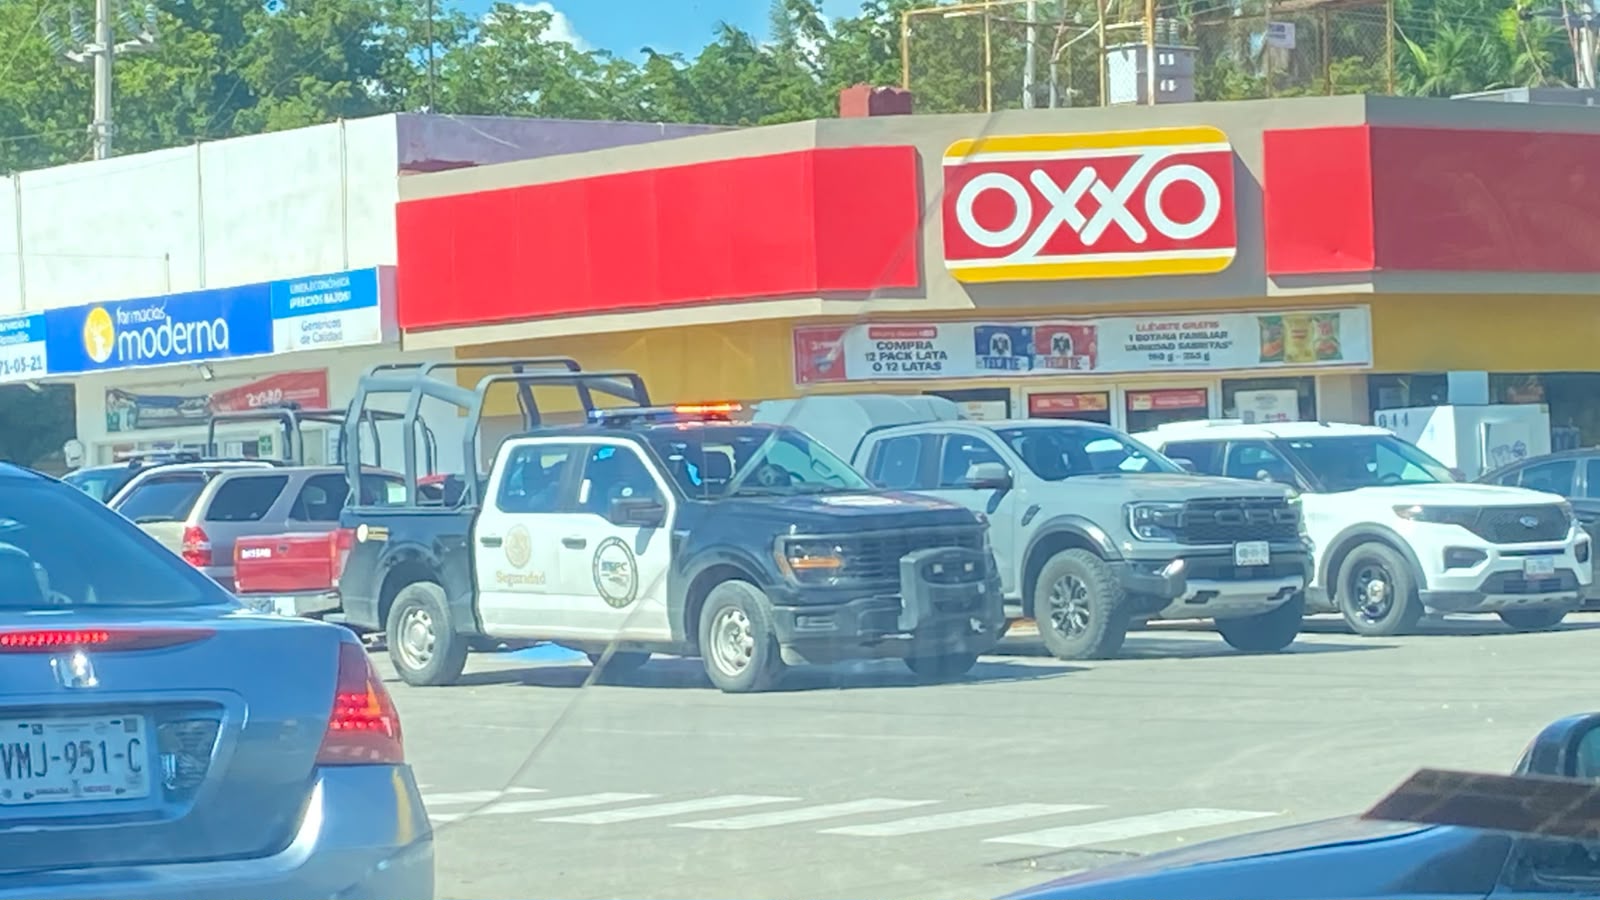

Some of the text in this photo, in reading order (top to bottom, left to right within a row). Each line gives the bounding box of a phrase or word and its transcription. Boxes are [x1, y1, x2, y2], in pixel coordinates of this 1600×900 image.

[956, 152, 1221, 260] OXXO
[117, 303, 167, 325] farmacias
[118, 316, 229, 361] moderna
[300, 330, 343, 344] de Calidad
[1135, 333, 1177, 342] BOTANA
[1179, 331, 1228, 340] FAMILIAR
[876, 341, 933, 350] COMPRA
[1125, 342, 1176, 352] VARIEDAD
[865, 351, 947, 362] 12 PACK LATA
[873, 361, 941, 372] O 12 LATAS
[496, 570, 546, 587] Seguridad
[0, 738, 142, 780] VMJ-951-C
